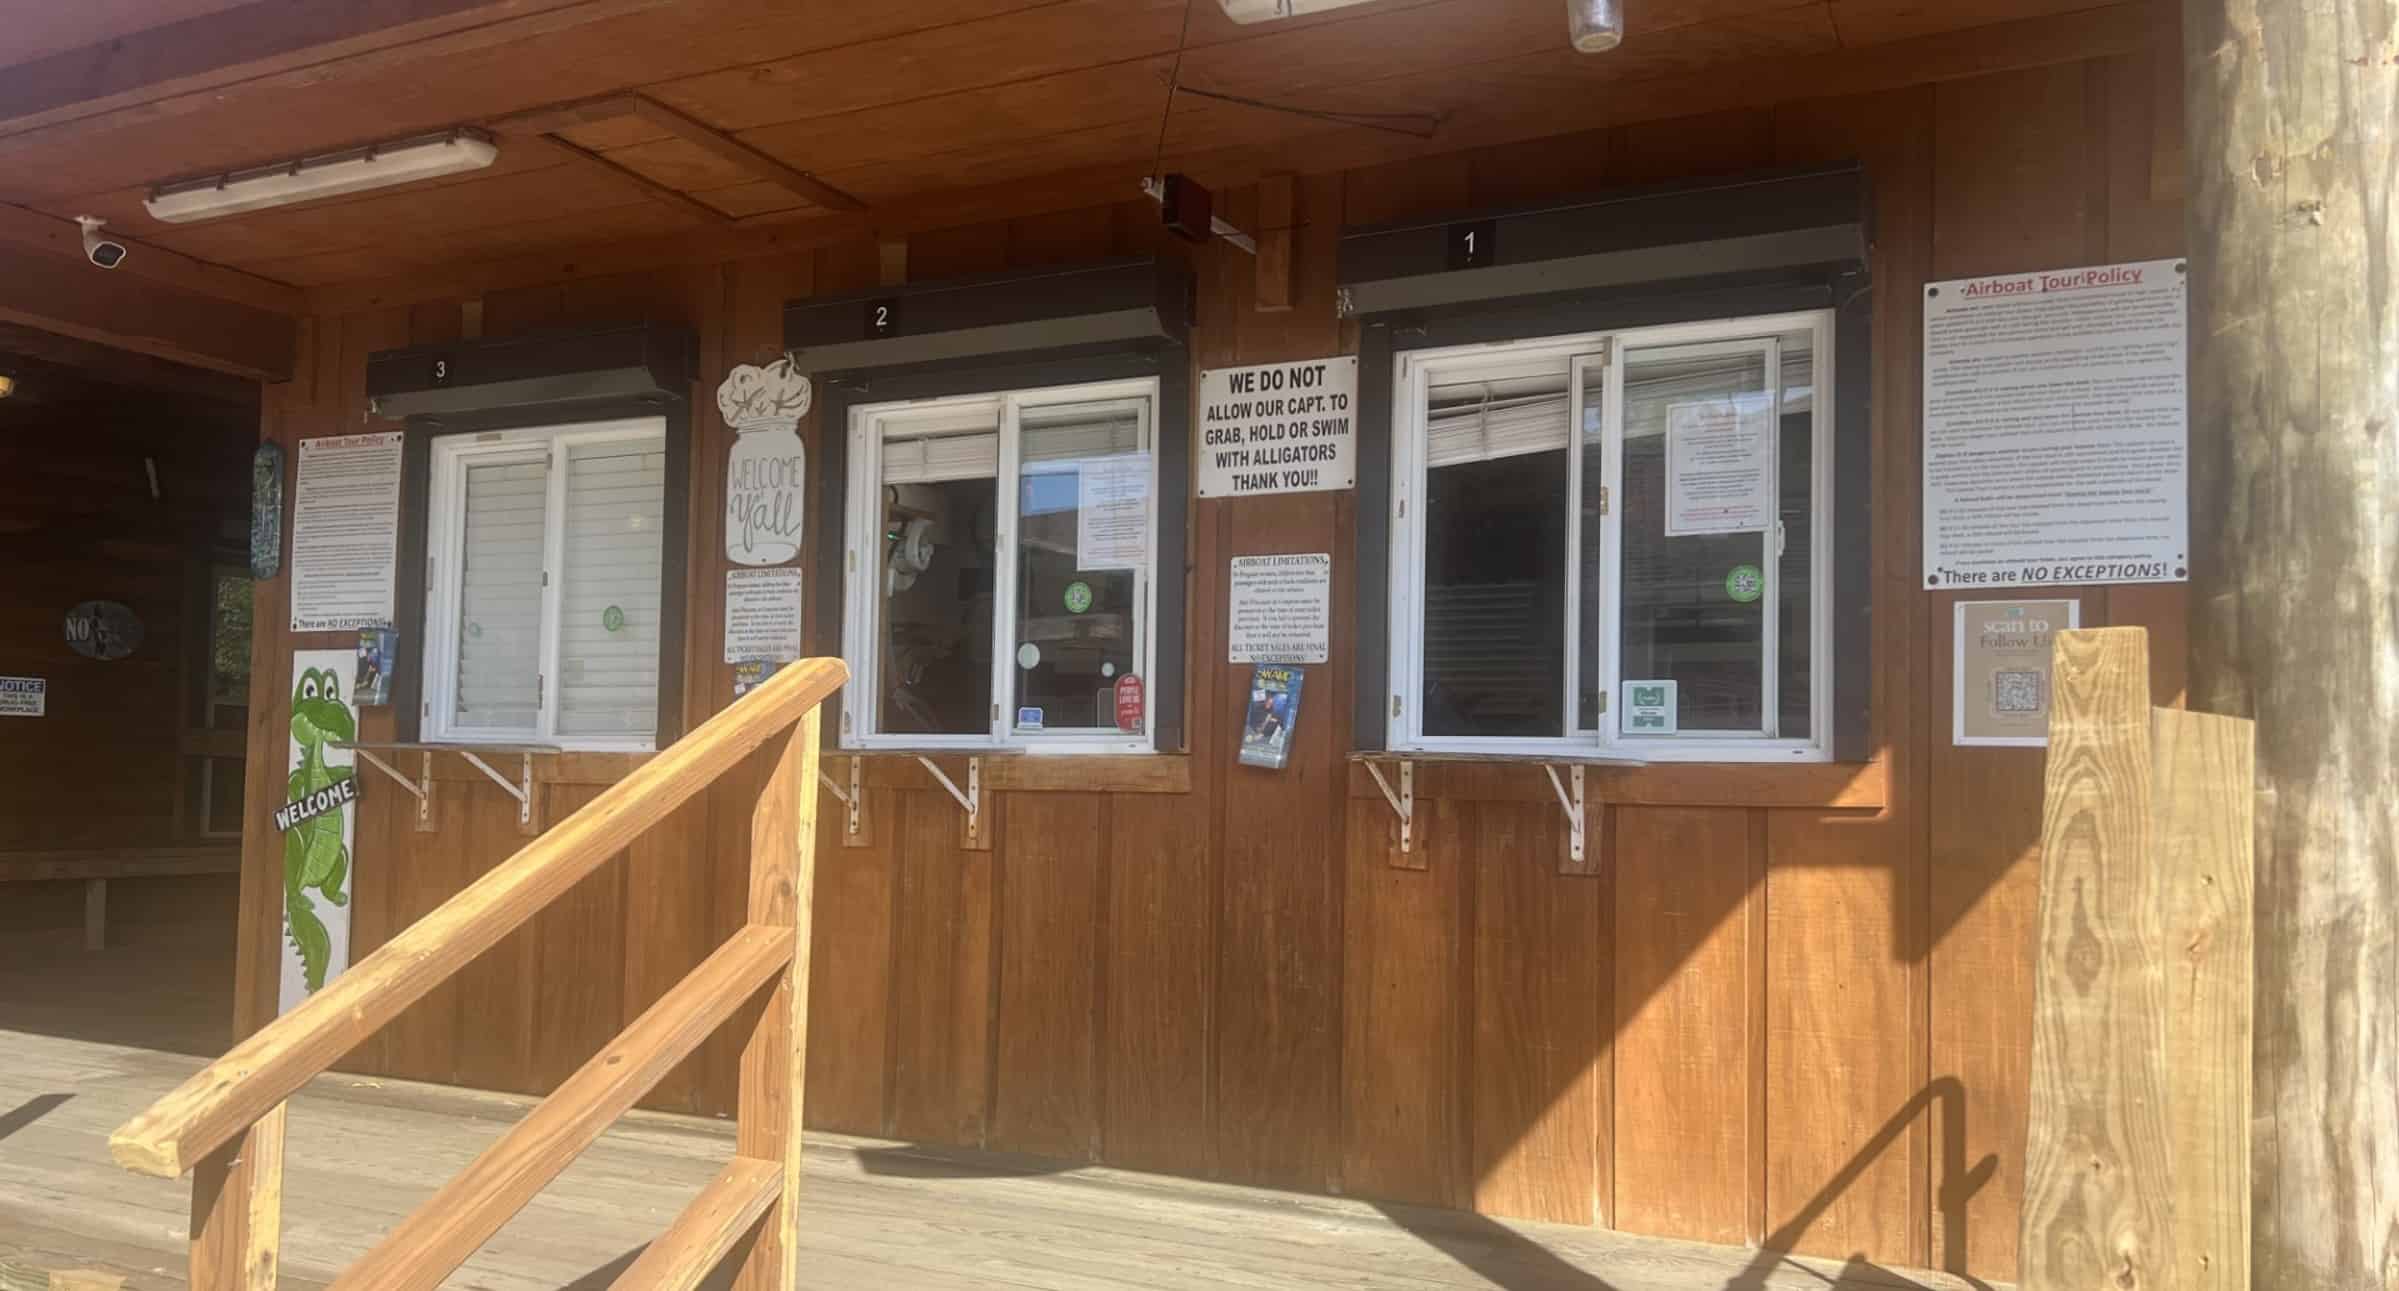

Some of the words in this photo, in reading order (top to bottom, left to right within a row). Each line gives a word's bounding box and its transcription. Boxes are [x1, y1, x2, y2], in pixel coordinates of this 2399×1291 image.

[1465, 231, 1475, 254] 1
[1966, 278, 2033, 298] Airboat
[2040, 272, 2082, 291] Tour
[2086, 266, 2143, 287] Policy
[876, 306, 888, 327] 2
[436, 360, 446, 378] 3
[1230, 372, 1255, 394] WE
[1260, 369, 1284, 391] DO
[1290, 365, 1326, 388] NOT
[1207, 402, 1252, 422] ALLOW
[1255, 400, 1284, 417] OUR
[1287, 395, 1326, 414] CAPT.
[1330, 393, 1348, 411] TO
[1206, 427, 1246, 446] GRAB,
[1250, 423, 1285, 442] HOLD
[1289, 421, 1308, 438] OR
[1311, 418, 1349, 437] SWIM
[1216, 450, 1249, 468] WITH
[1253, 443, 1337, 465] ALLIGATORS
[731, 456, 801, 490] WELCOME
[1232, 471, 1278, 491] THANK
[1282, 469, 1319, 488] YOU!!
[1943, 569, 1987, 585] There
[1990, 570, 2017, 583] are
[2021, 567, 2049, 582] NO
[2052, 563, 2168, 582] EXCEPTIONS!
[66, 617, 90, 641] NO
[1984, 619, 2025, 633] scan
[2030, 617, 2049, 632] to
[1980, 634, 2028, 649] Follow
[276, 779, 354, 831] WELCOME
